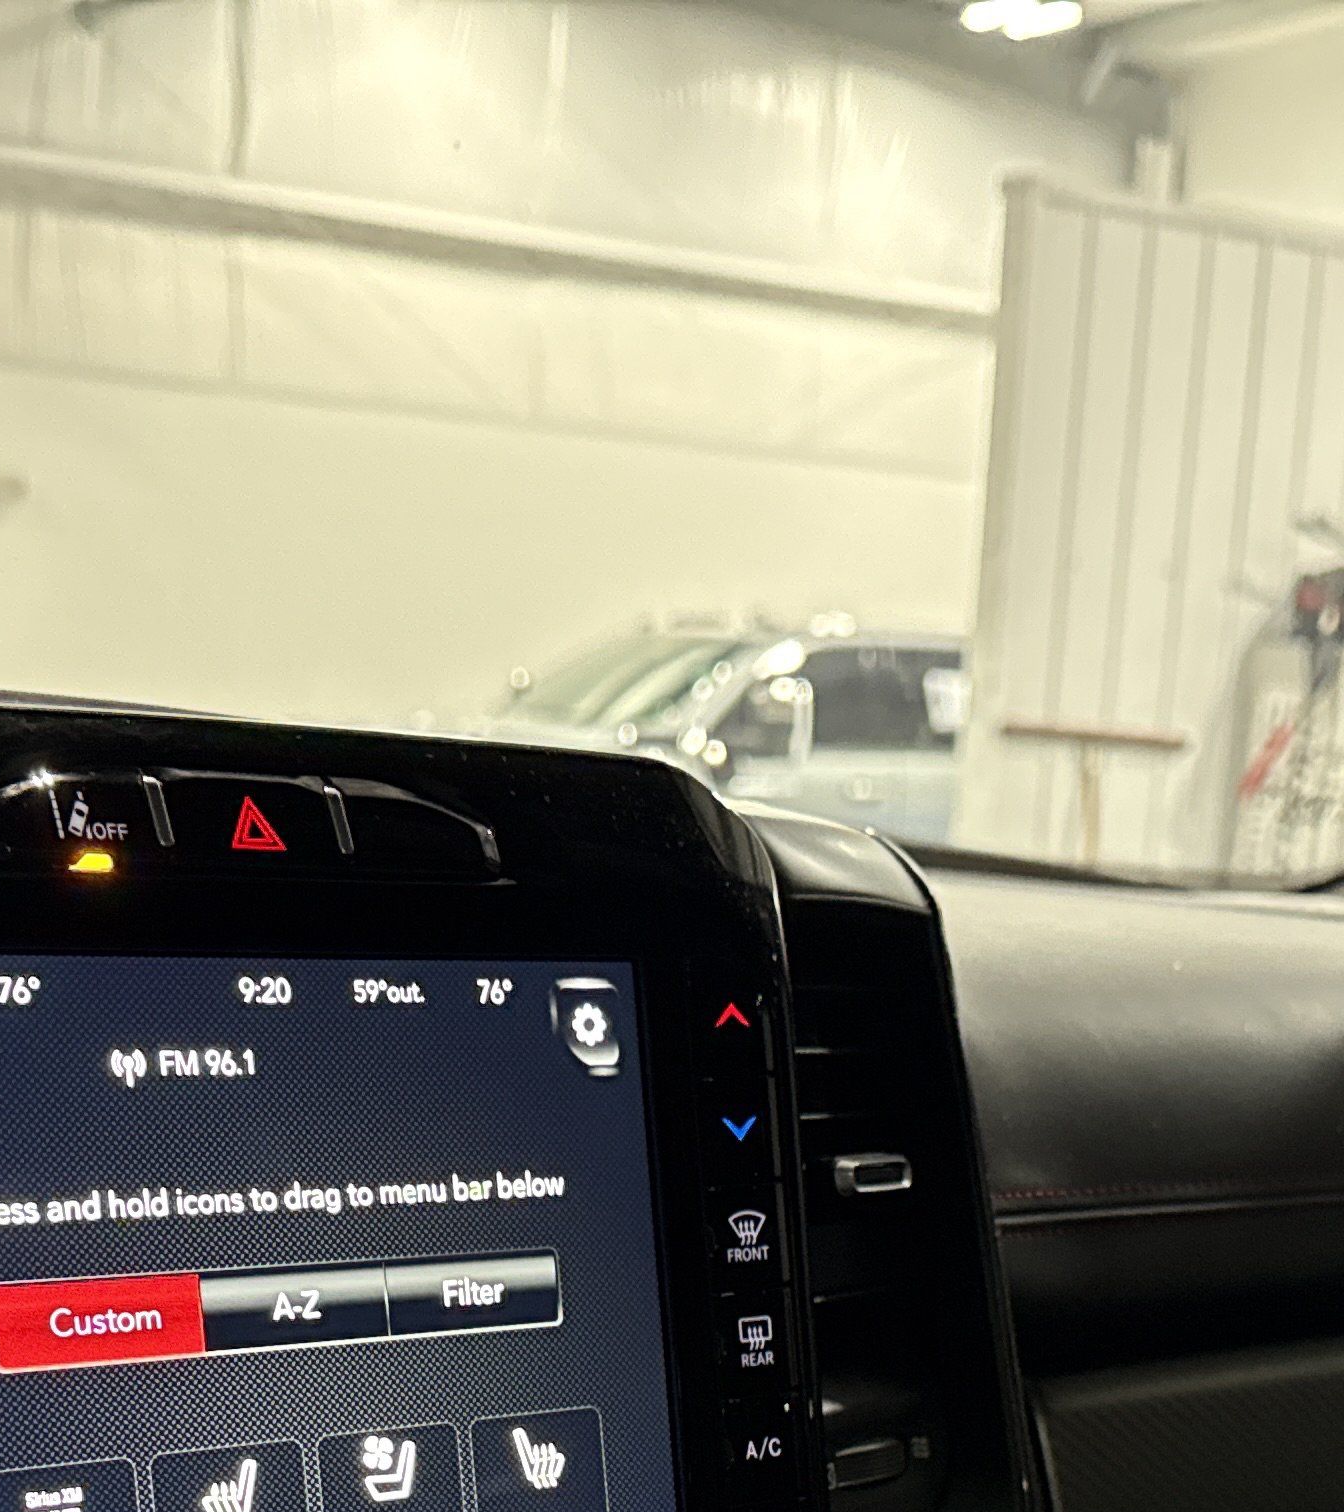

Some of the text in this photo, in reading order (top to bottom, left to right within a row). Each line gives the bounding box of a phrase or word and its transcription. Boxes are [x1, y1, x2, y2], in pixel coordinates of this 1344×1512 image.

[92, 822, 128, 841] OFF
[237, 976, 292, 1005] 9:20
[158, 1048, 256, 1078] FM 96.1
[46, 1189, 102, 1224] and
[107, 1186, 170, 1221] hold
[175, 1187, 246, 1217] icons
[247, 1187, 279, 1215] to
[282, 1180, 342, 1215] drag
[345, 1182, 374, 1209] to
[379, 1182, 448, 1206] menu
[451, 1172, 493, 1202] bar
[495, 1169, 565, 1200] below
[727, 1244, 770, 1263] FRONT
[272, 1289, 321, 1322] A-Z
[441, 1276, 505, 1309] Filter
[49, 1307, 163, 1338] Custom
[741, 1350, 775, 1368] REAR
[745, 1436, 782, 1460] A/C
